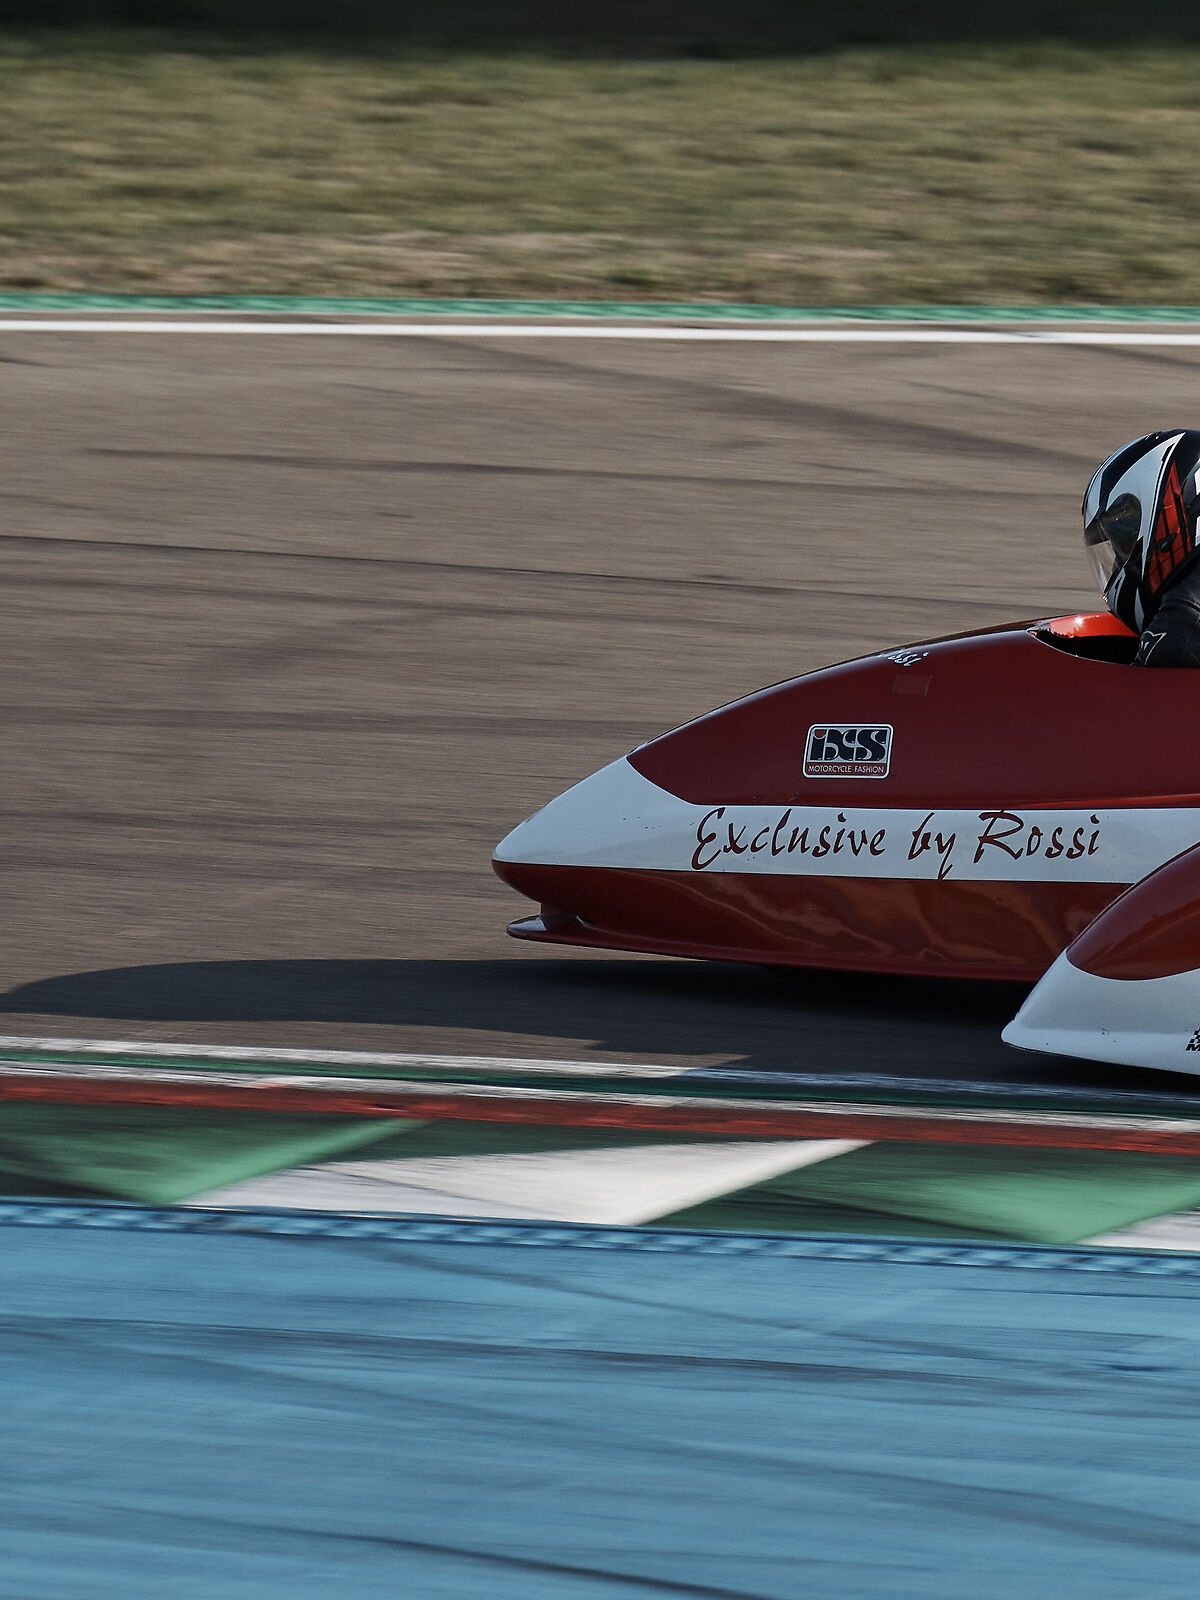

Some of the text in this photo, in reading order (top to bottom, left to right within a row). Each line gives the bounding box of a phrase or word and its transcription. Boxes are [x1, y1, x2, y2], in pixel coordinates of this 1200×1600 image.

[808, 765, 885, 773] MOTORCYCLE FASHION
[691, 806, 1101, 880] Exclusive by Rossi
